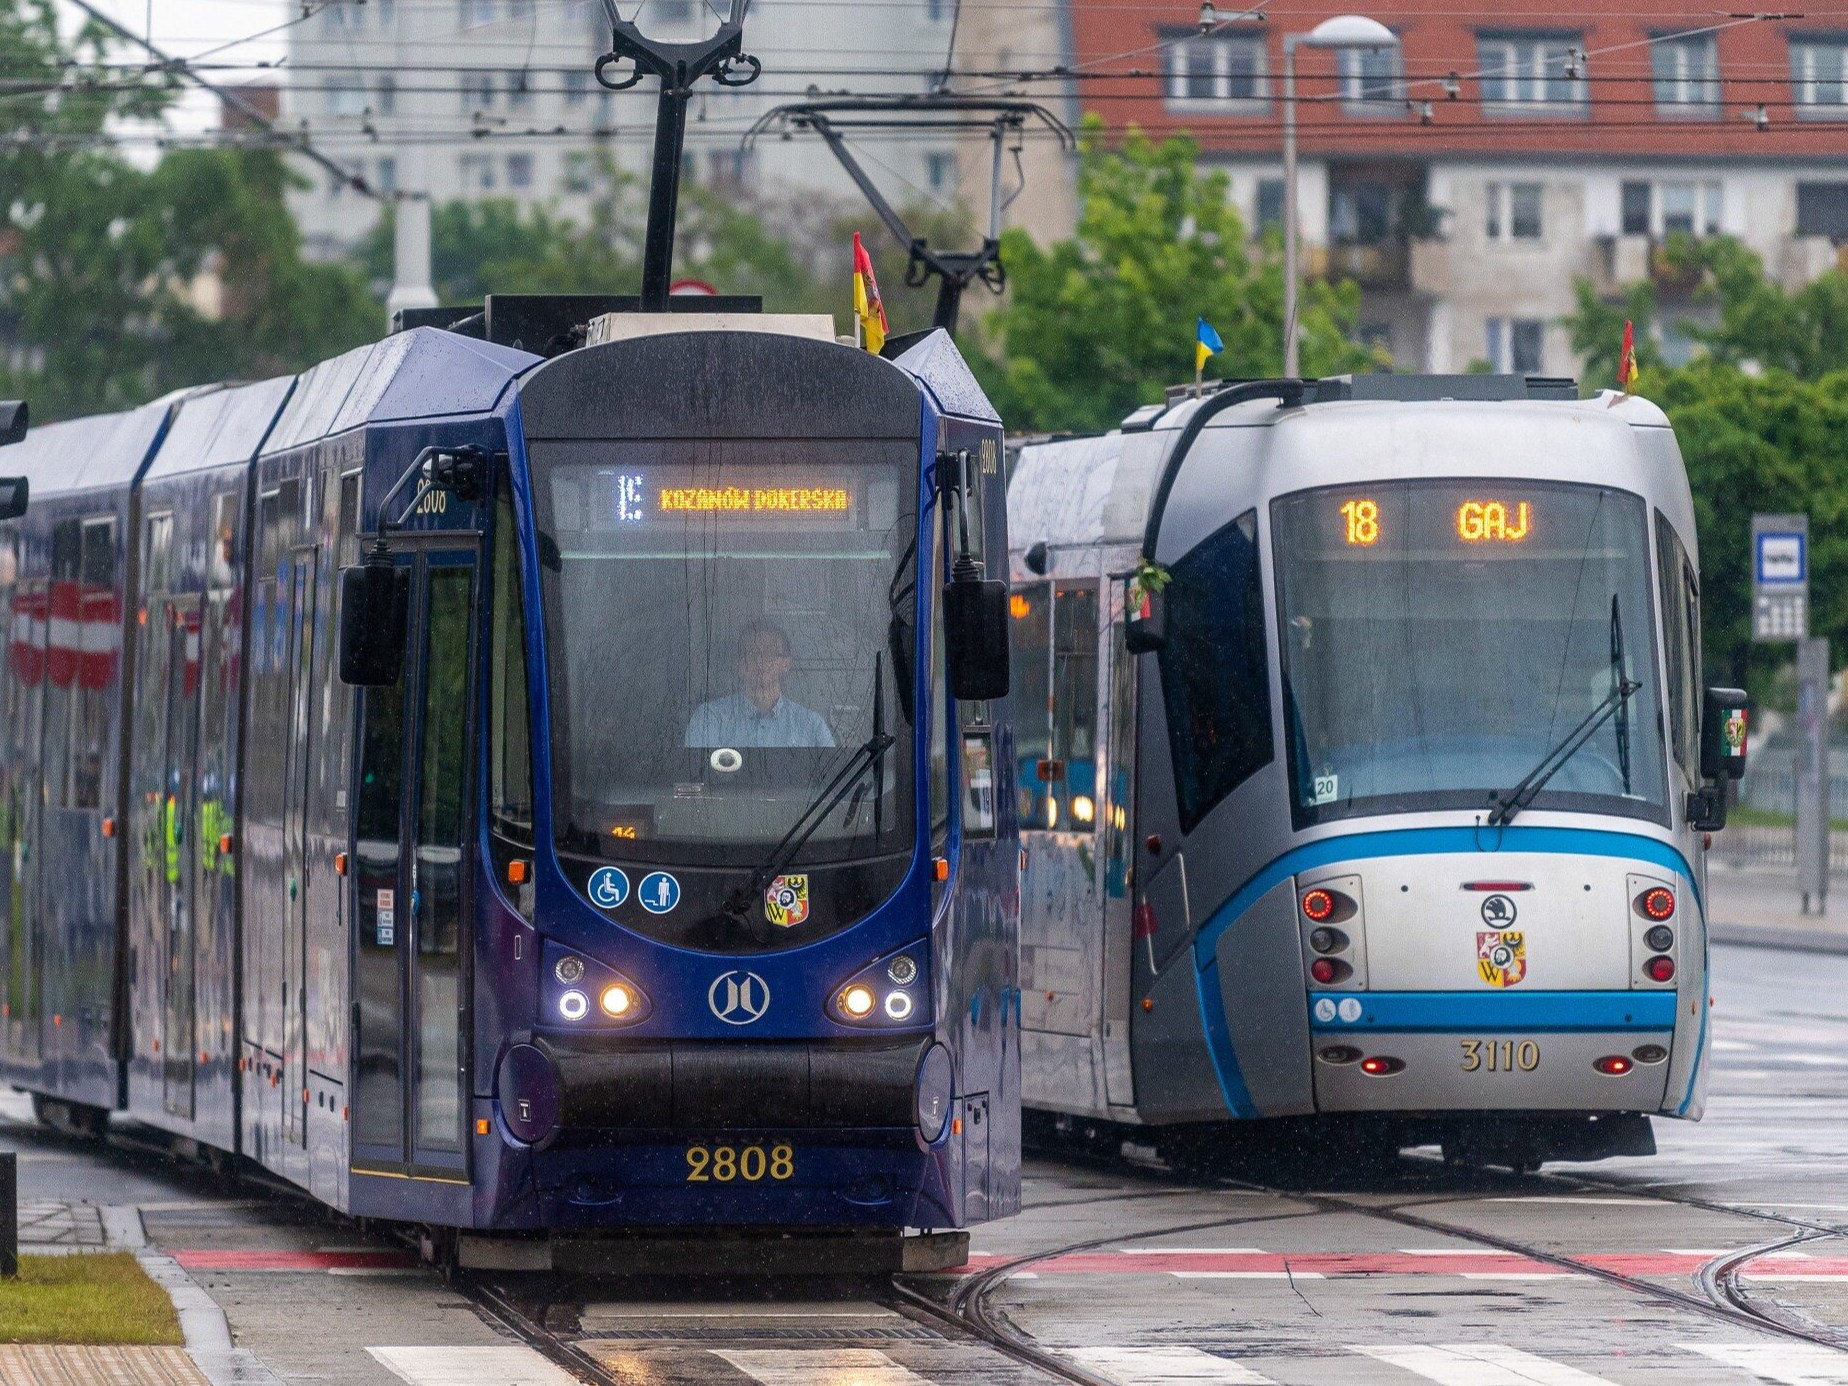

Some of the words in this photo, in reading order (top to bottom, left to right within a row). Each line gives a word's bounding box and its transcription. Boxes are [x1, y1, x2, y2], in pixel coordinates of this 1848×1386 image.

[1340, 500, 1378, 544] 18
[1457, 500, 1529, 541] GAJ
[1317, 780, 1335, 795] 20
[1459, 1039, 1540, 1072] 3110
[685, 1144, 795, 1182] 2808
